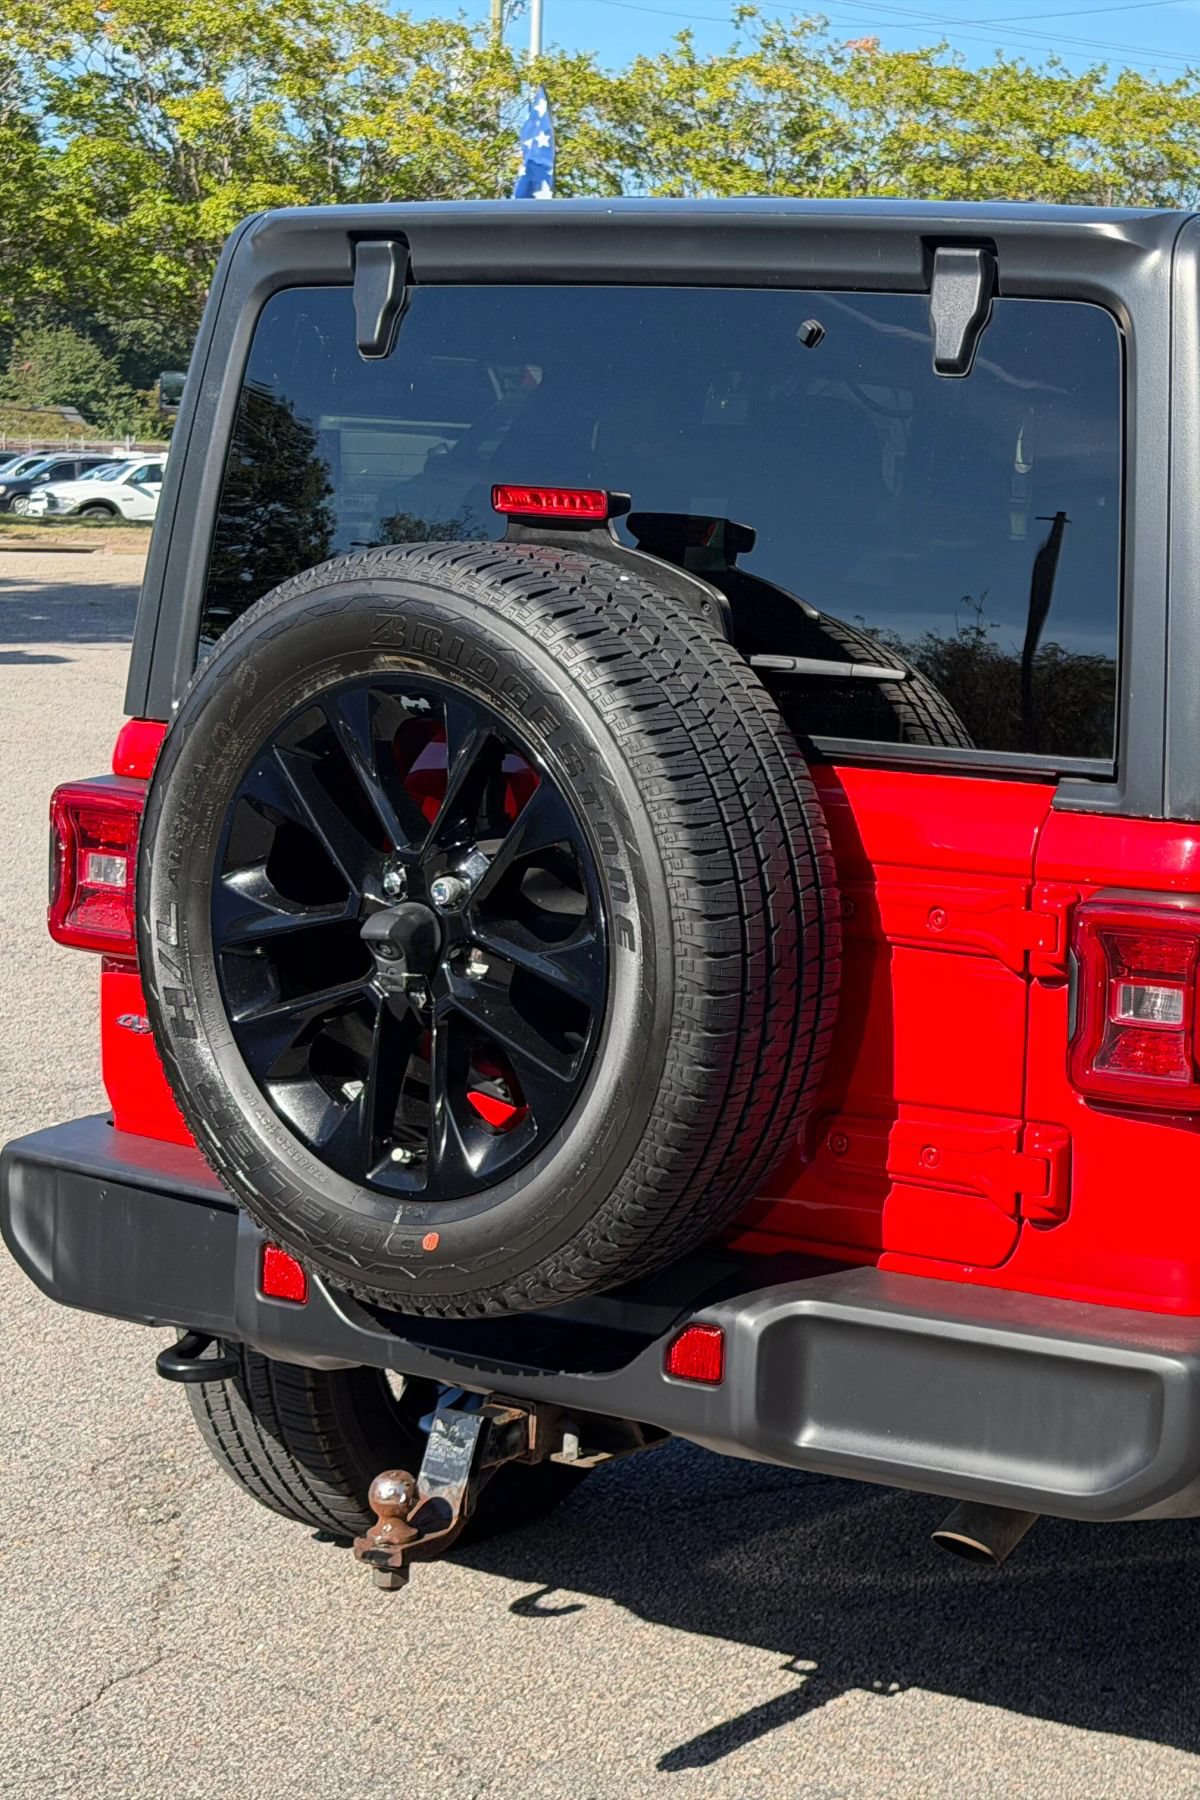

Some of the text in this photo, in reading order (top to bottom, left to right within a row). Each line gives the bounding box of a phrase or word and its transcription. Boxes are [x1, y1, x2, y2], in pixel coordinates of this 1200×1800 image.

[367, 612, 636, 952] BRIDGESTONE
[157, 902, 197, 1039] H/L
[195, 1083, 426, 1258] DUELER
